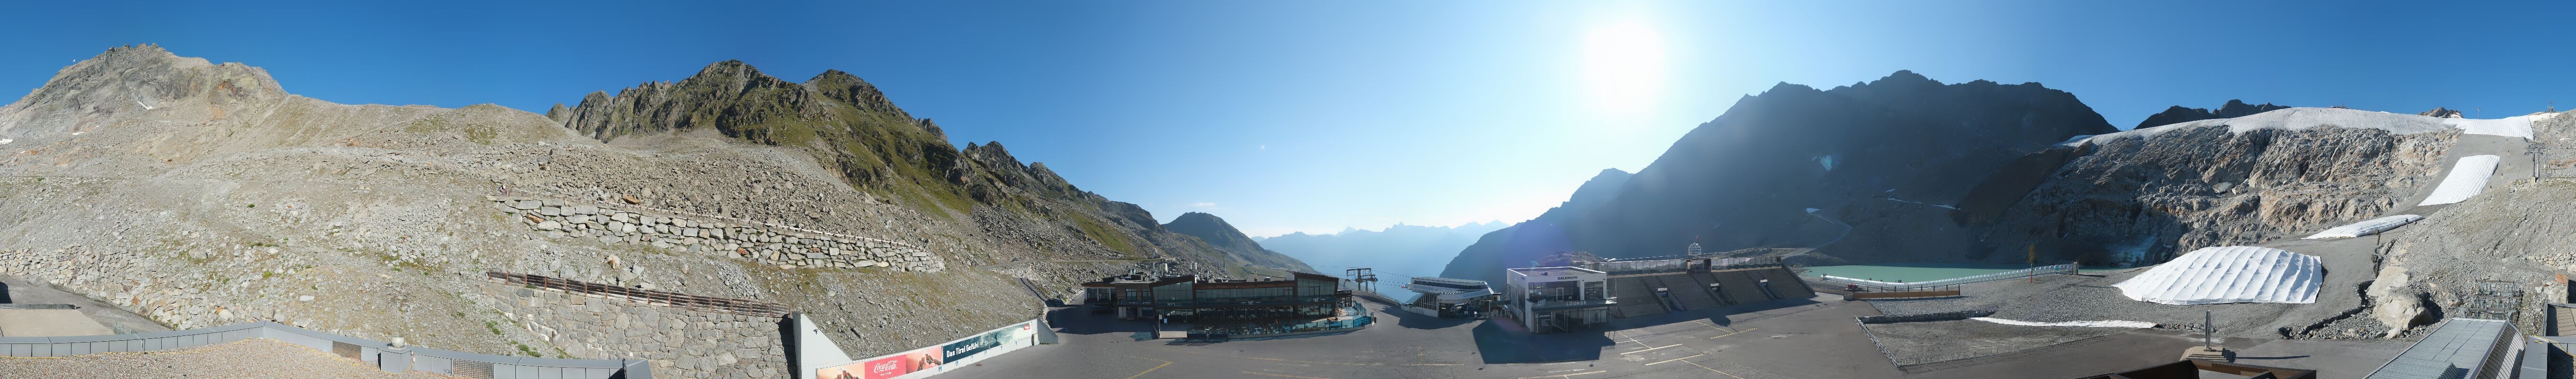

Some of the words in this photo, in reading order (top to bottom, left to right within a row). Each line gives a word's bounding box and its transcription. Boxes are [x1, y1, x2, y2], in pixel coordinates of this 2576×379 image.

[947, 350, 955, 358] Das
[956, 345, 966, 355] Tirol
[966, 341, 979, 352] Gefühl
